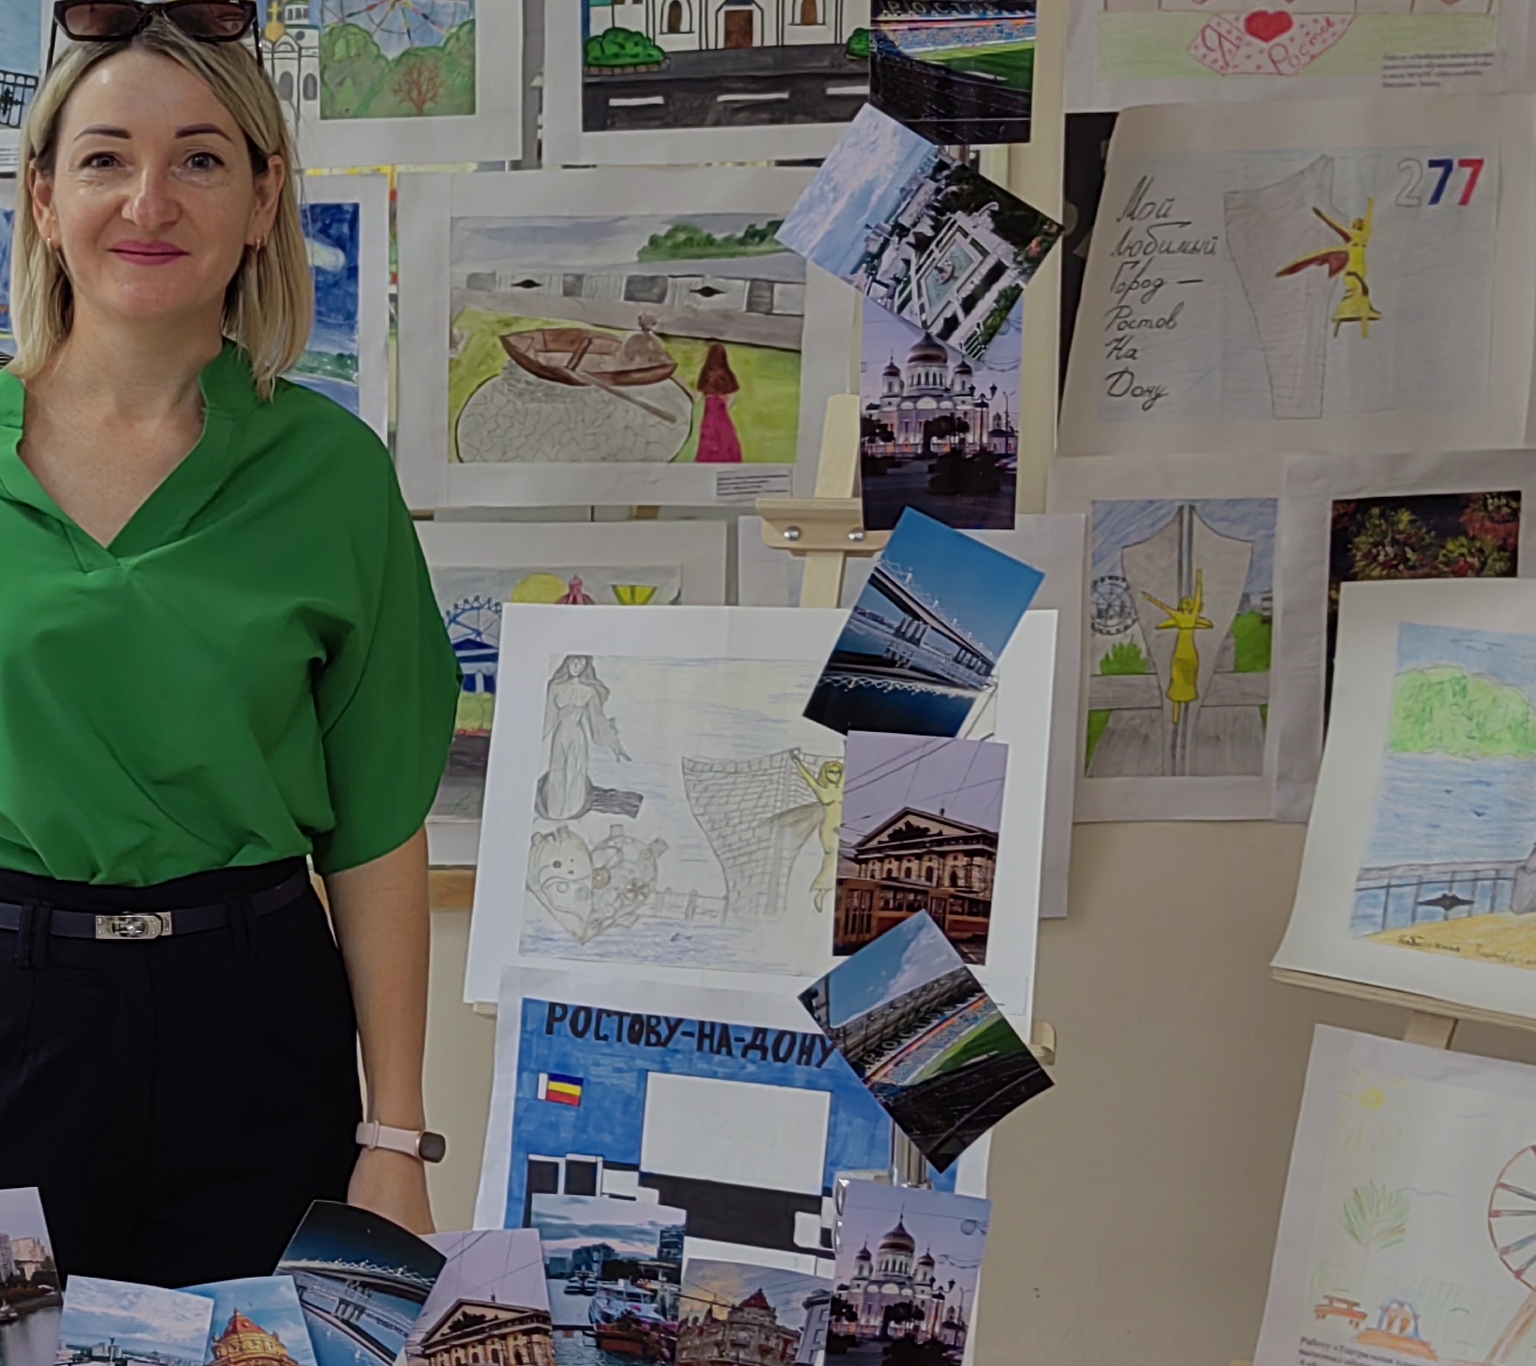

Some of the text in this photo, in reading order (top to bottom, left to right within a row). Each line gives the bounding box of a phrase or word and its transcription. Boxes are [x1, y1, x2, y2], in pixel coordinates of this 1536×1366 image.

[1116, 175, 1175, 223] Мой
[1395, 158, 1485, 207] 277
[1104, 301, 1184, 332] Ростов
[1105, 335, 1138, 360] На
[1105, 366, 1169, 412] Дону
